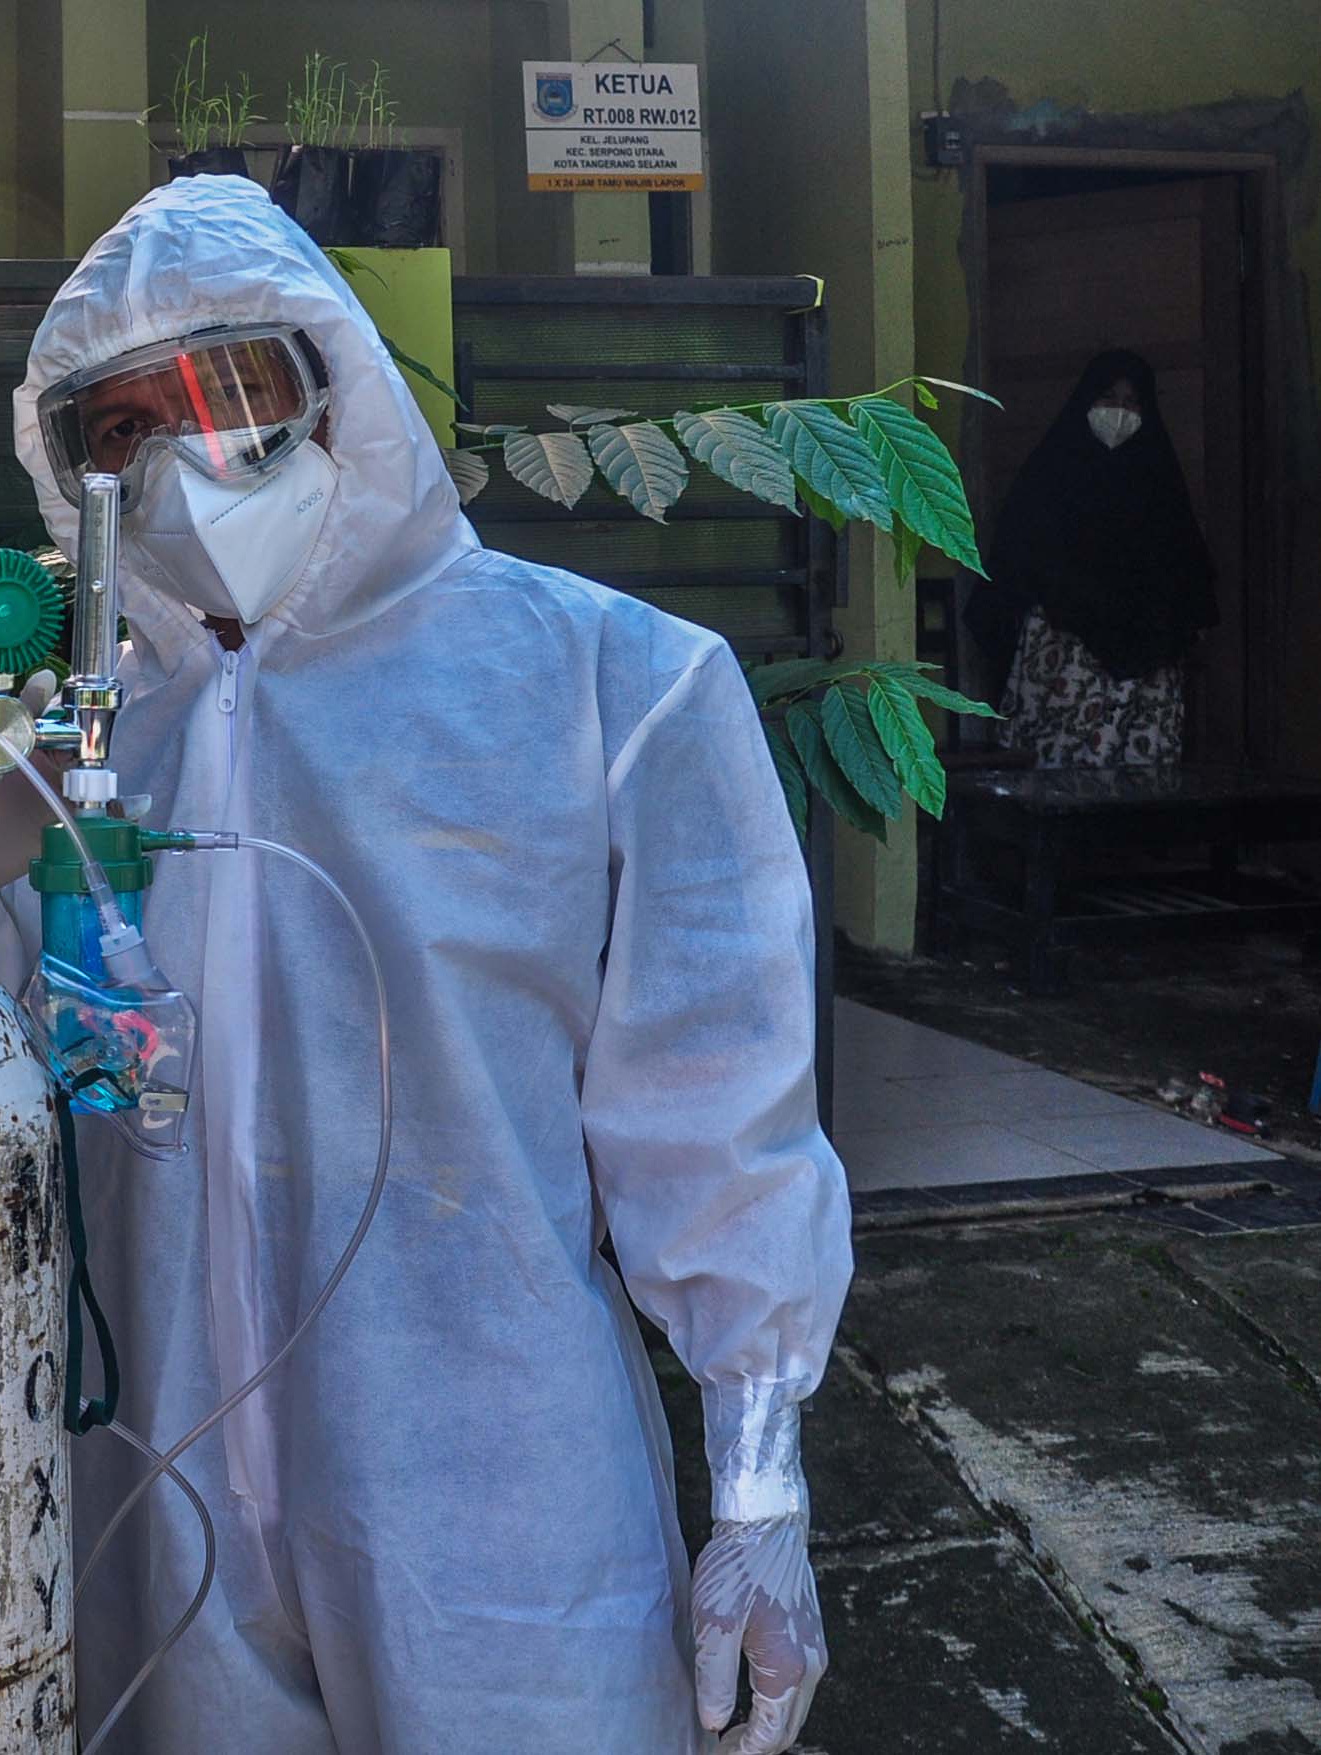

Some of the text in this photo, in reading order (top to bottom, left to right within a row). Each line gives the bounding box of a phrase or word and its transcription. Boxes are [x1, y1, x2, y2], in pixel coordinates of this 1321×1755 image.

[595, 73, 673, 95] KETUA
[583, 108, 696, 125] RT.008 RW.012
[580, 136, 649, 144] KEL. JELUPANG
[566, 148, 665, 157] KEC. SERPONG UTARA
[554, 160, 678, 168] KOTA TANGERANG SELATAN
[295, 487, 324, 513] KN95
